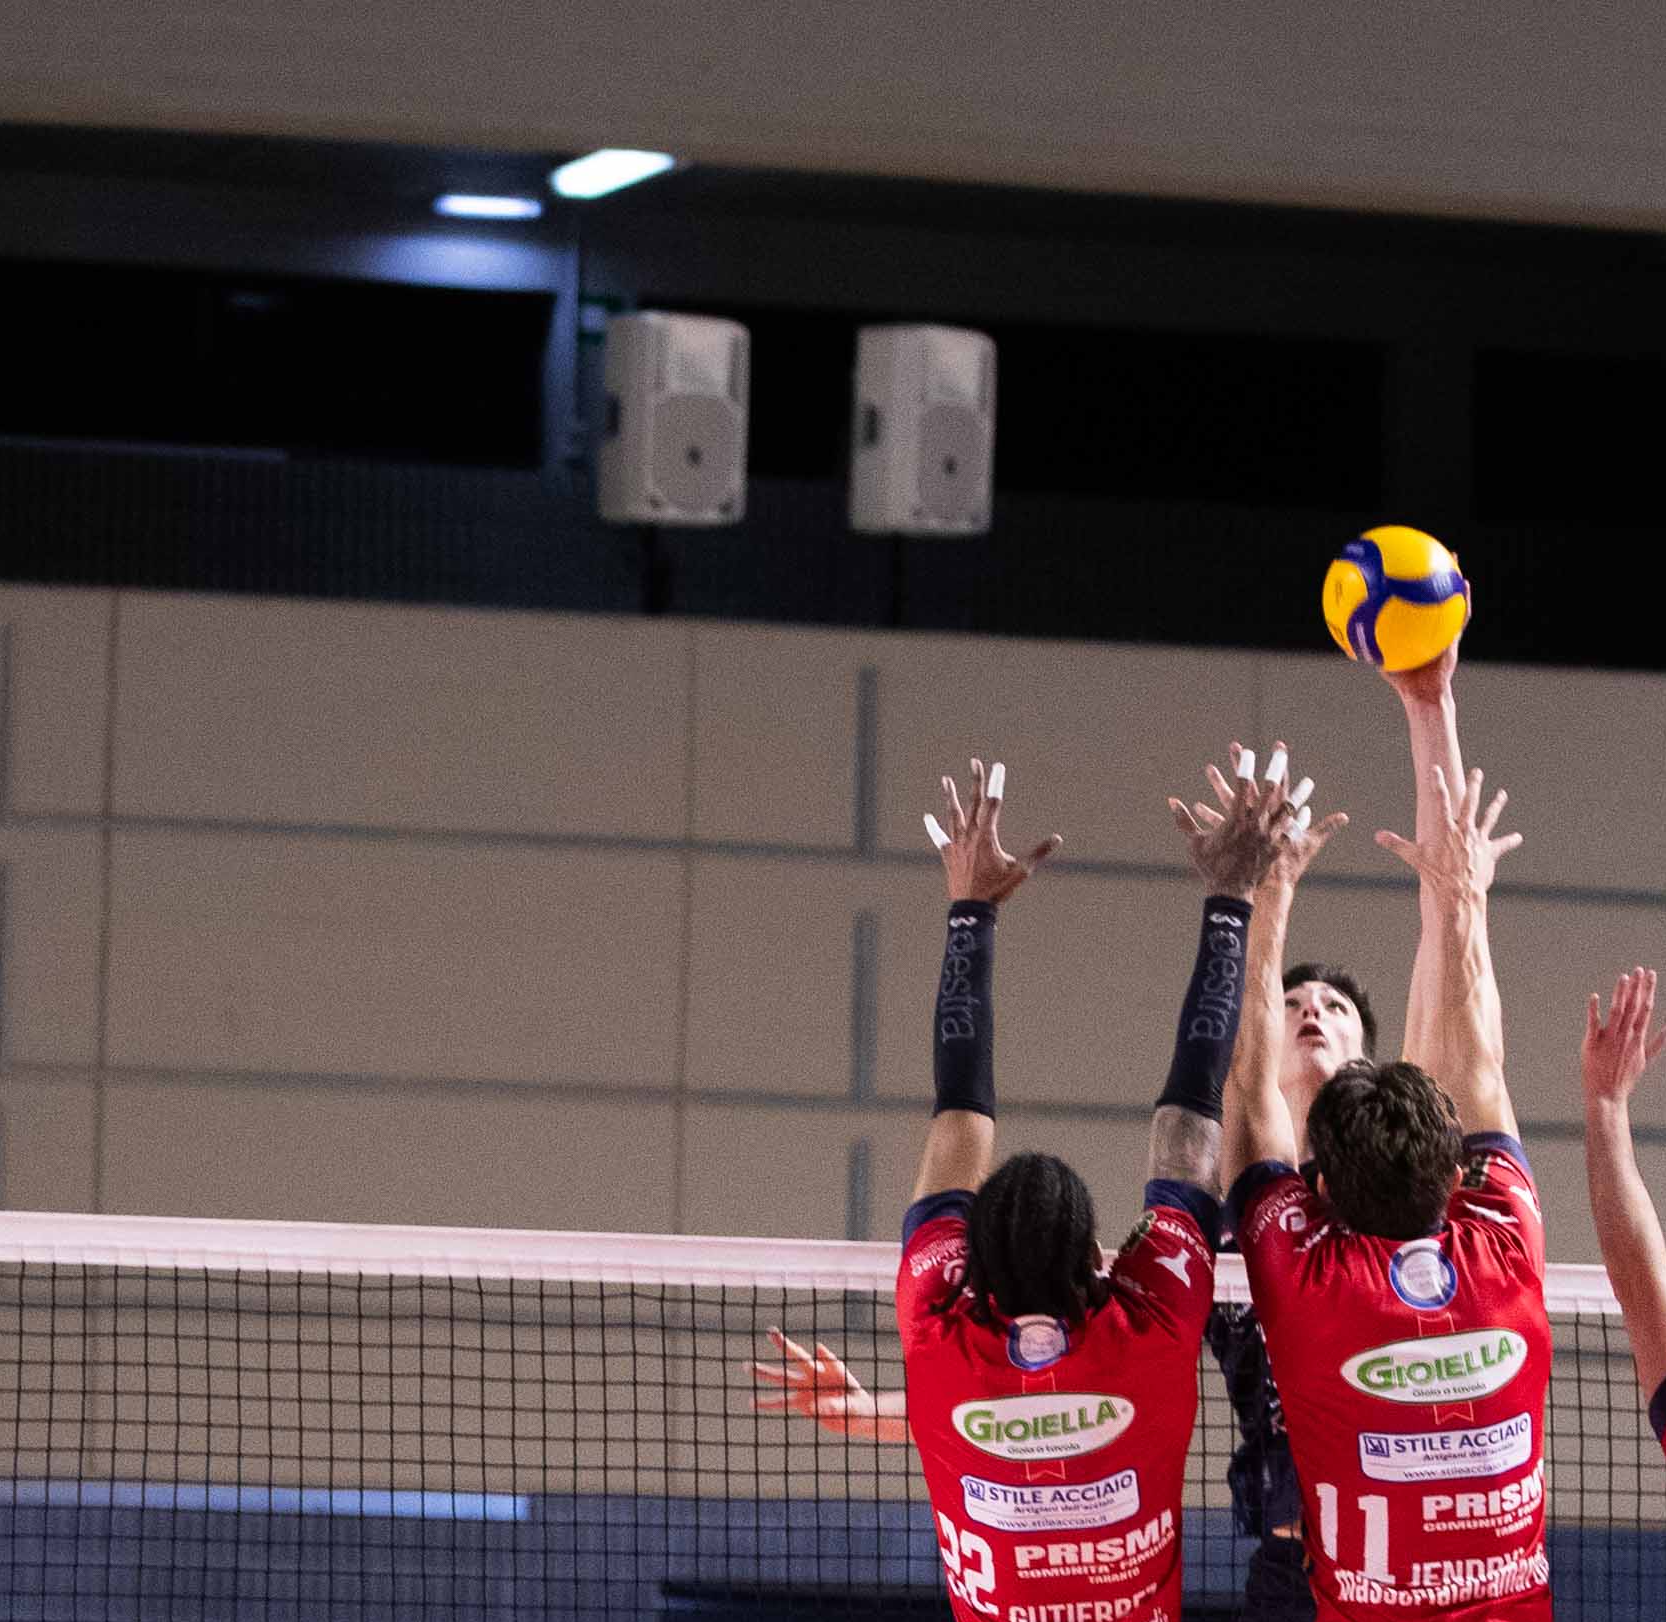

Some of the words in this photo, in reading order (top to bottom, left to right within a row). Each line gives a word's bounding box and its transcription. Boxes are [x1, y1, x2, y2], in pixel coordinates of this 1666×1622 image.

[1355, 1335, 1515, 1391] GIOIELLA
[963, 1399, 1119, 1442] GIOIELLA
[1394, 1435, 1452, 1453] STILE
[1458, 1418, 1529, 1448] ACCIAIO
[989, 1487, 1043, 1505] STILE
[1050, 1473, 1134, 1504] ACCIAIO
[1315, 1482, 1396, 1585] 11
